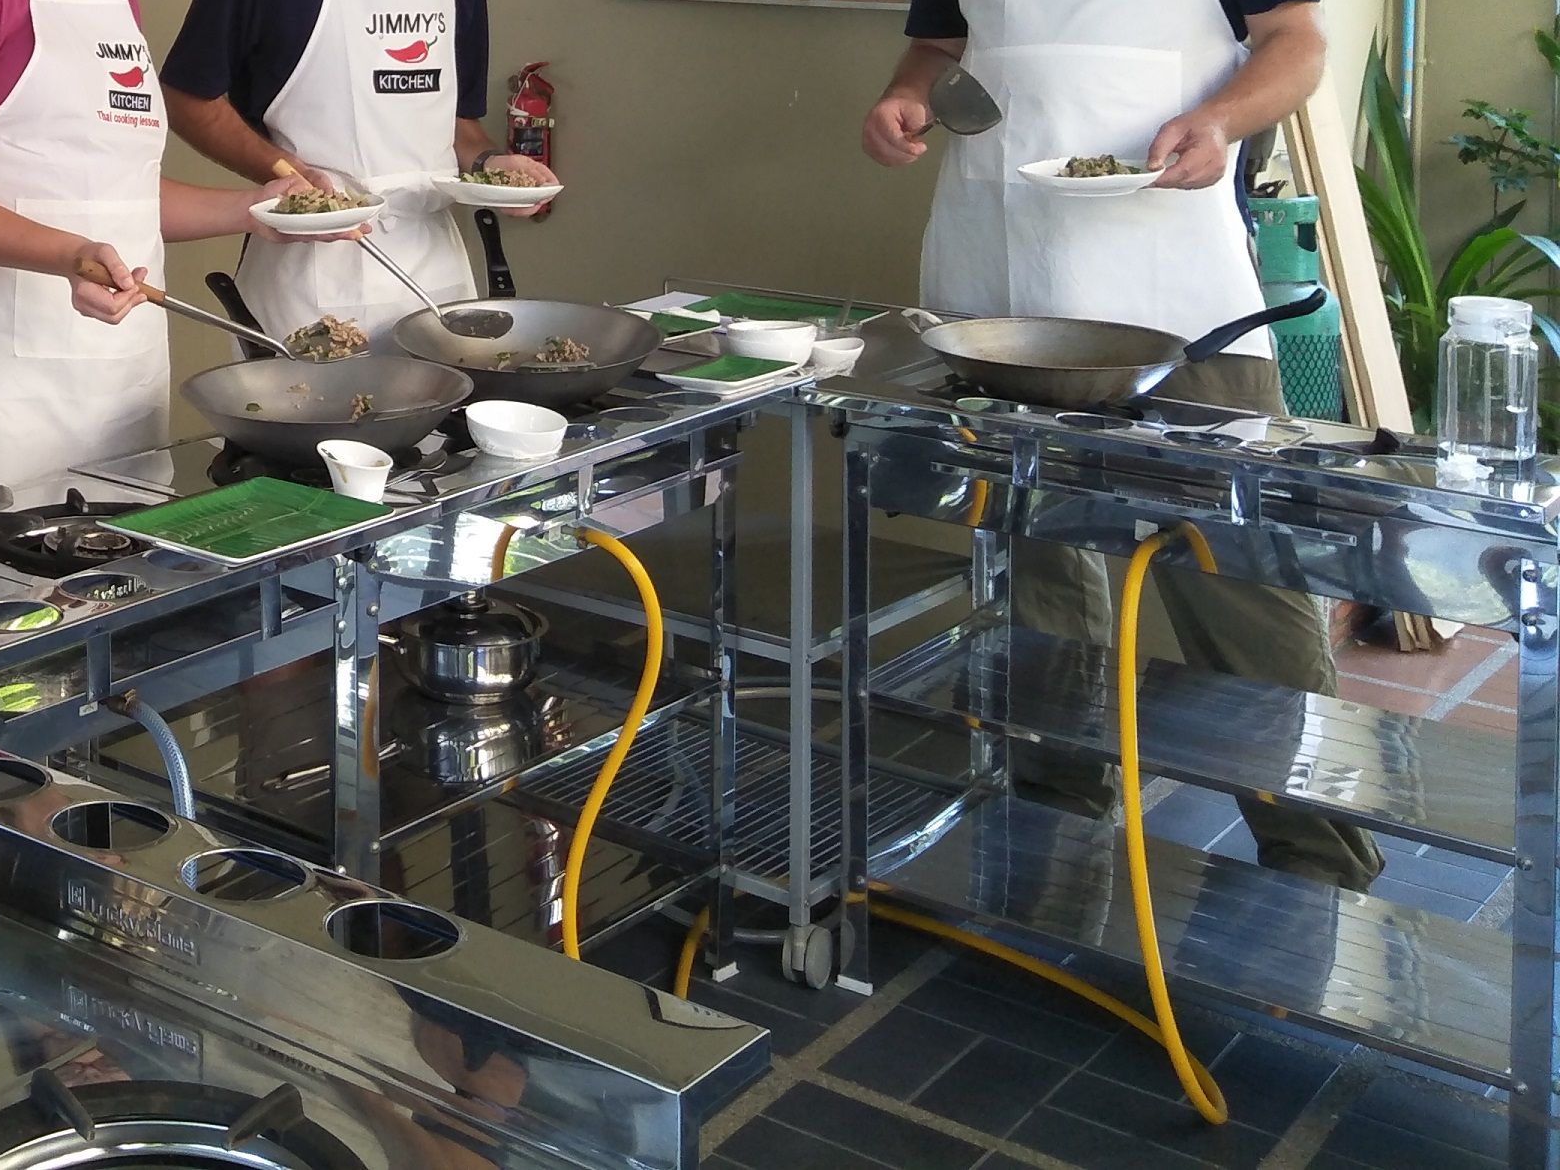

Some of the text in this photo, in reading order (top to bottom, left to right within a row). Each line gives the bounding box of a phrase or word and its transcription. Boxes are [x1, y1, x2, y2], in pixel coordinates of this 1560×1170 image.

[365, 11, 447, 35] JIMMY'S
[379, 73, 435, 90] KITCHEN
[110, 92, 150, 110] KITCHEN
[96, 110, 113, 123] Thai
[113, 113, 138, 128] cooking
